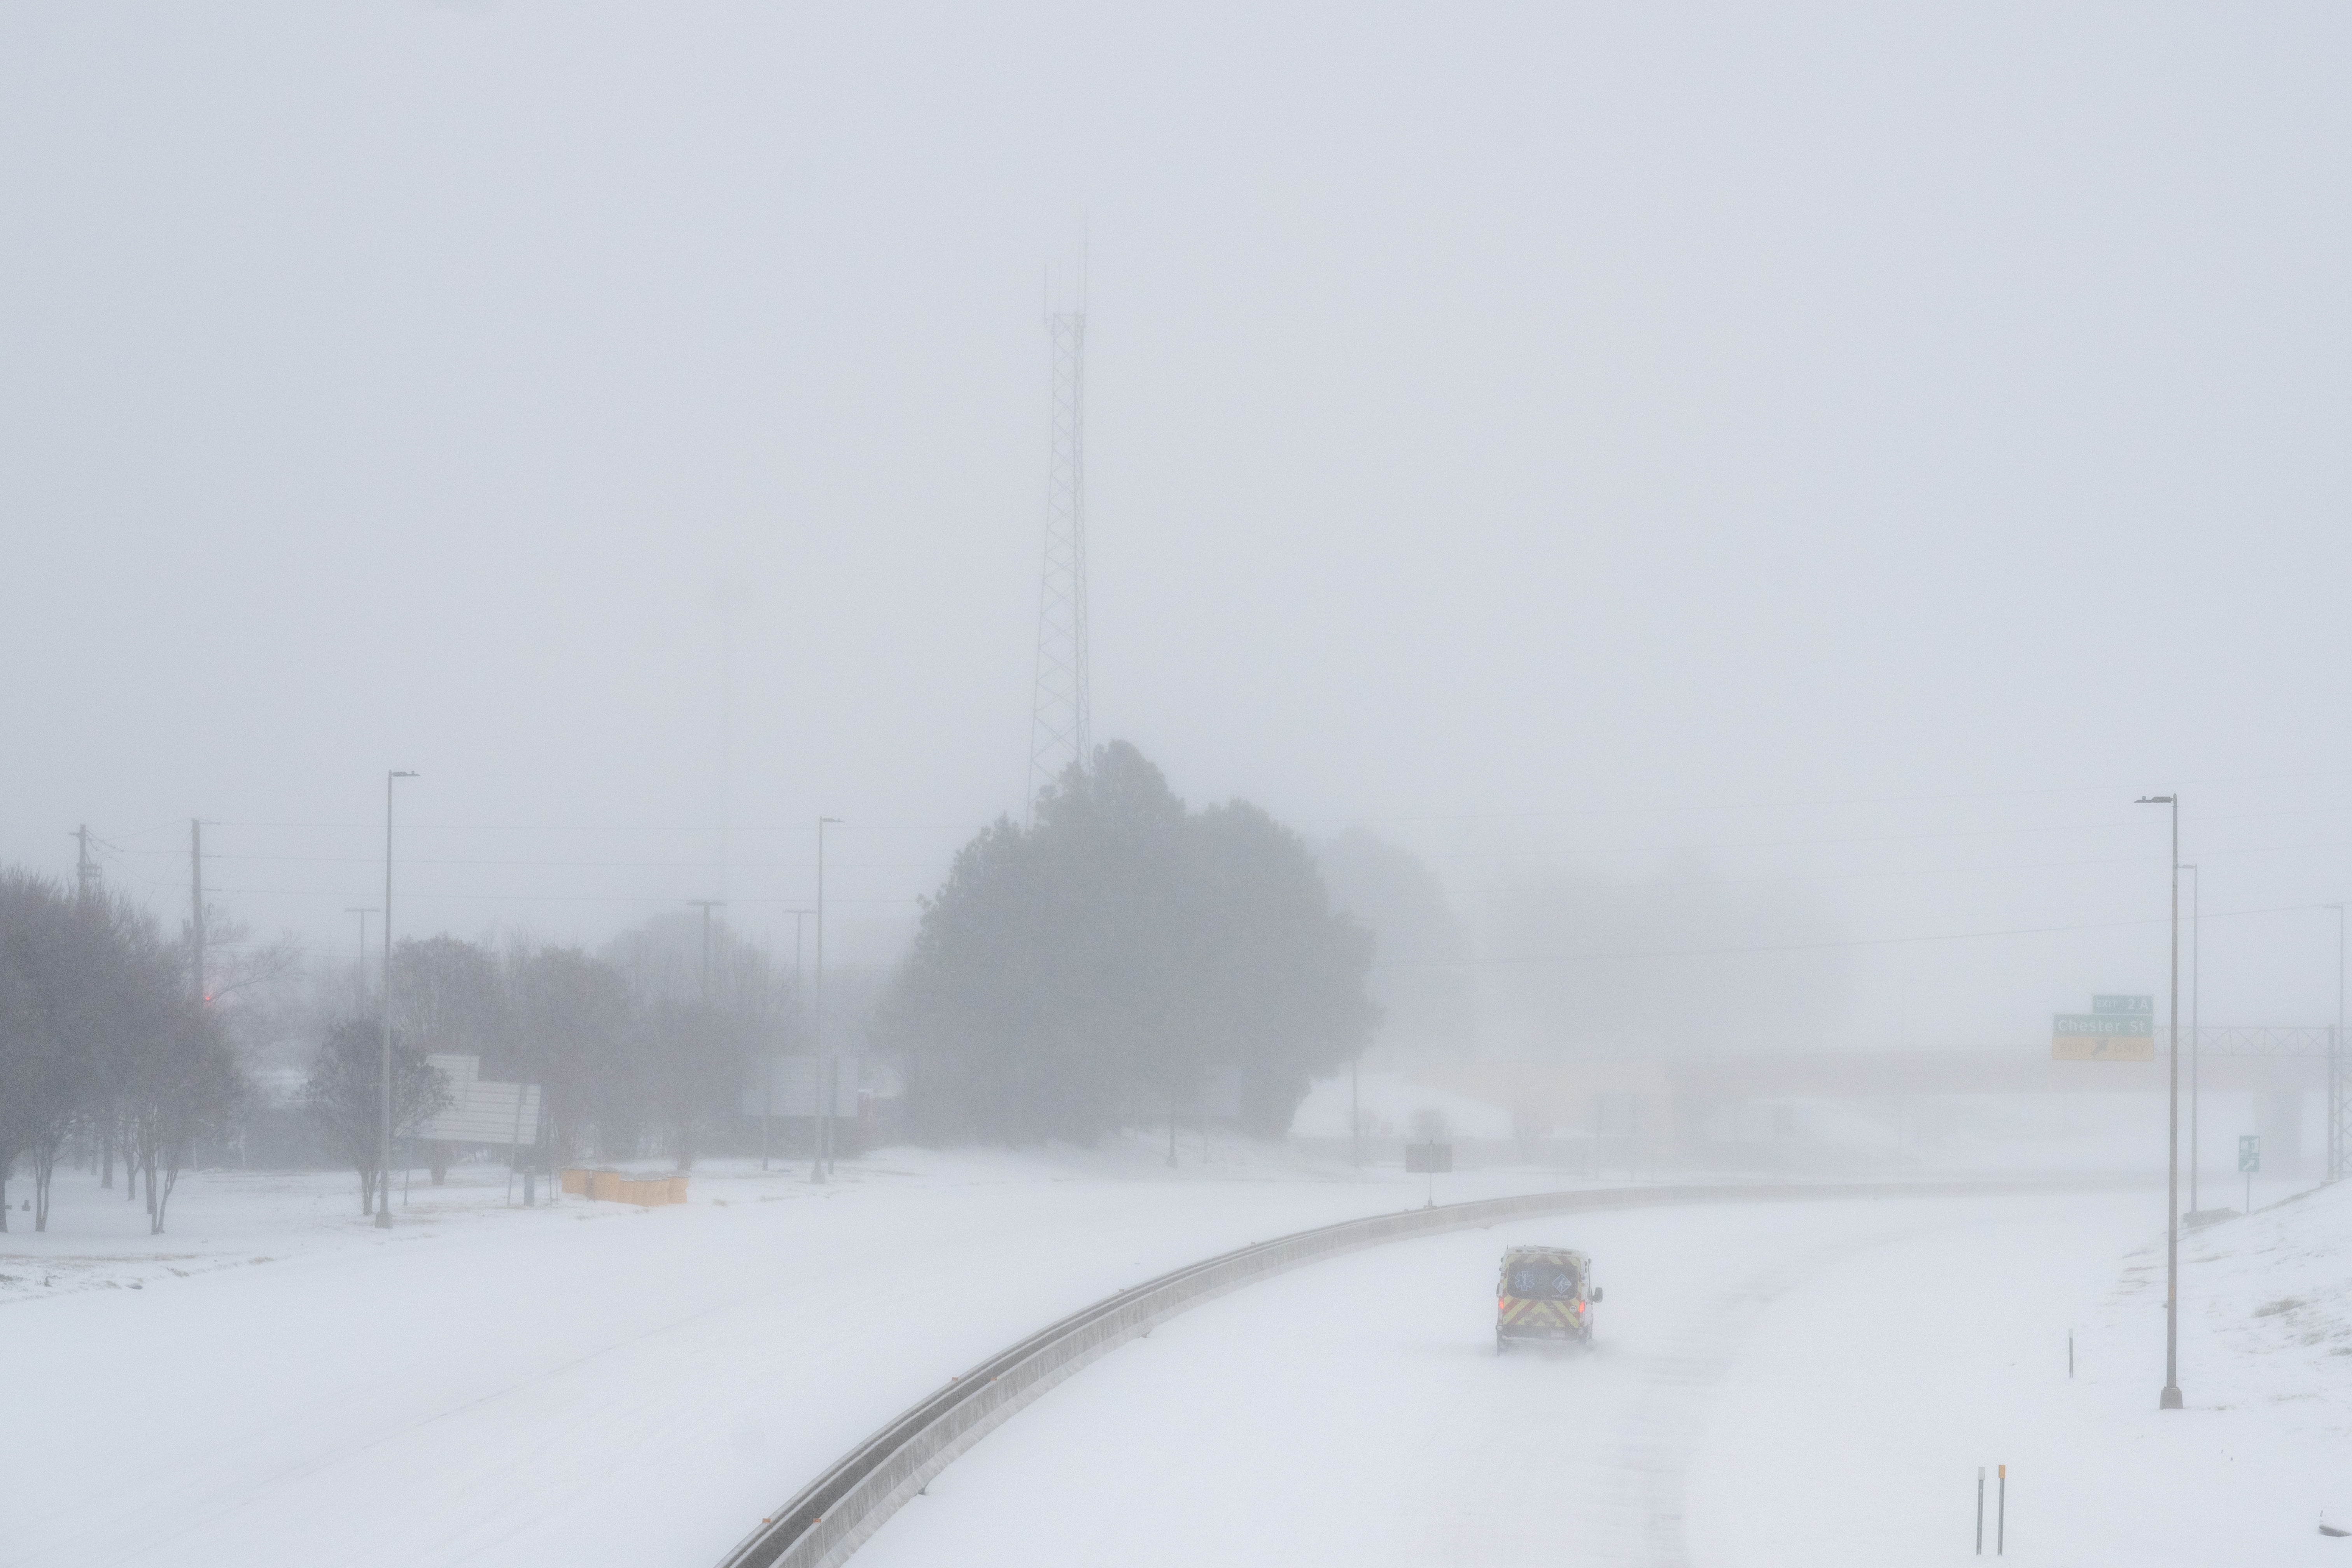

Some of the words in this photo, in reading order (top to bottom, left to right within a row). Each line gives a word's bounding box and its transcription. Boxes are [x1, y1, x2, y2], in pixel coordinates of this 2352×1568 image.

[2096, 999, 2118, 1008] EXIT
[2058, 1019, 2121, 1032] Chester
[2130, 1020, 2146, 1032] St
